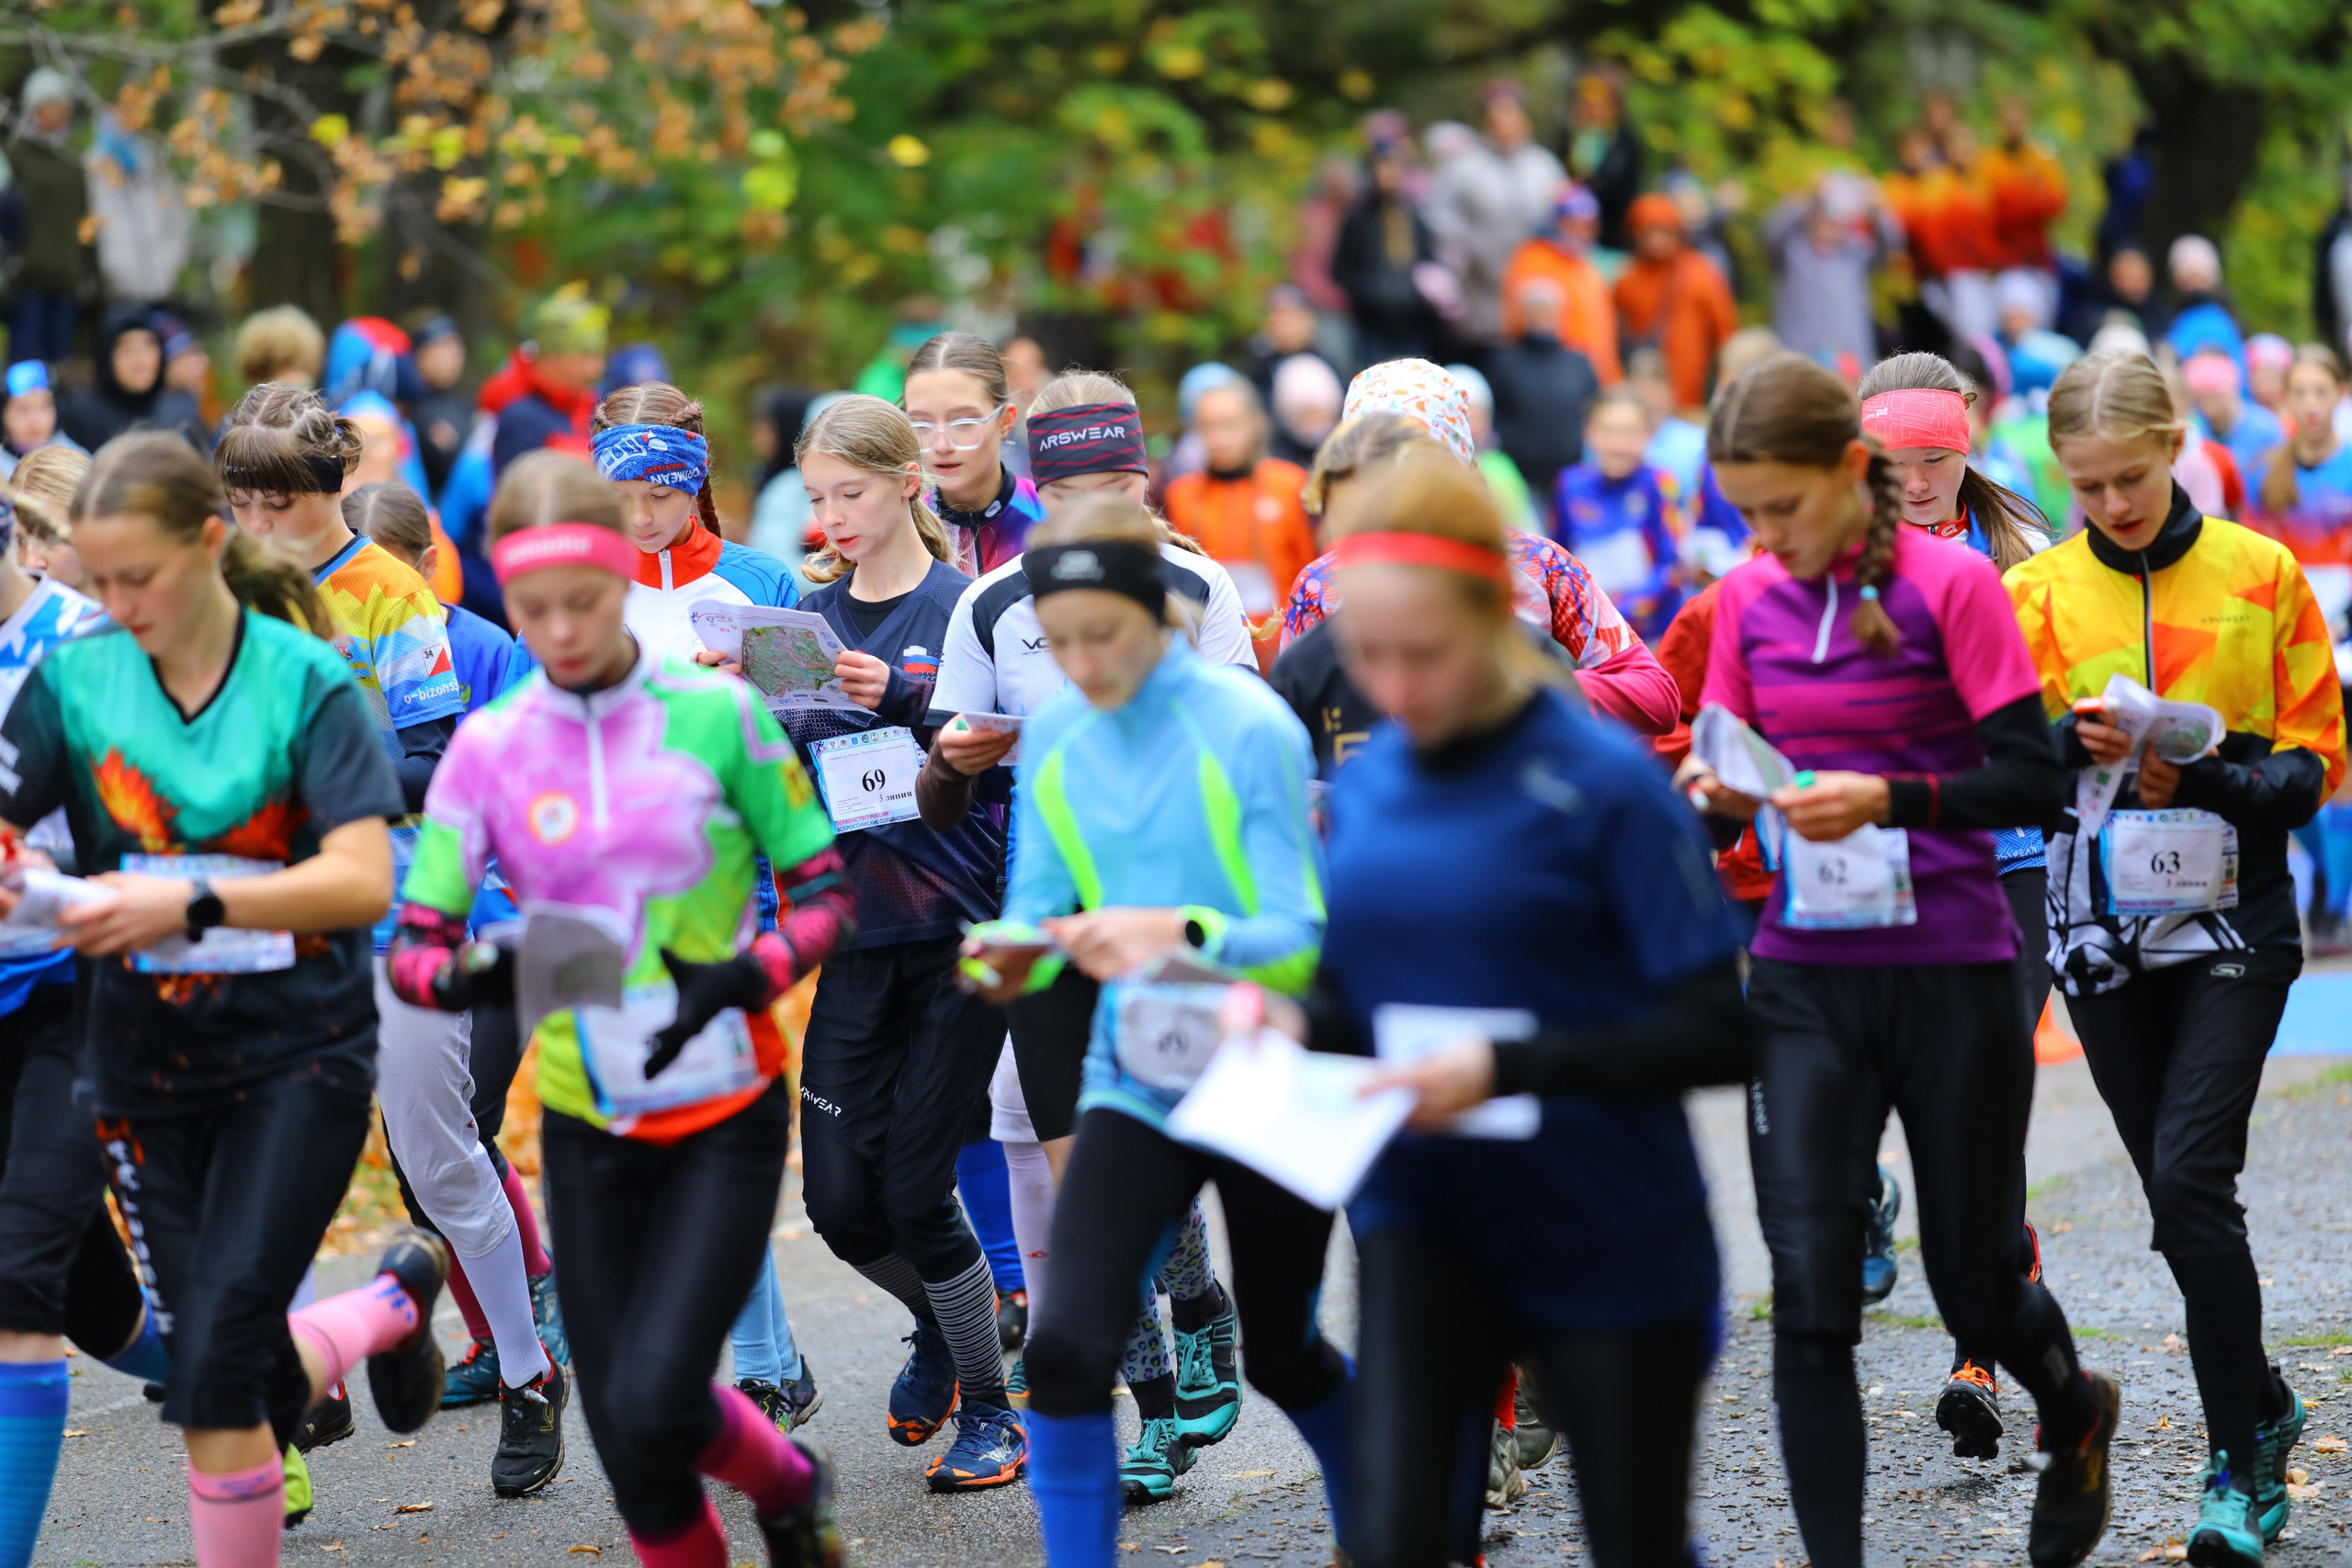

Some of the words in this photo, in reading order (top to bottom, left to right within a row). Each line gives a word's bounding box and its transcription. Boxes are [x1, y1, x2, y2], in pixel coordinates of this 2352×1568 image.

[1039, 426, 1125, 452] ARSWEAR
[650, 466, 700, 486] CRIMEAN
[423, 649, 435, 660] 34
[862, 769, 886, 792] 69
[879, 794, 883, 802] 3
[885, 791, 912, 801] линия
[835, 816, 869, 827] ПЕРВЕНСТВО
[869, 811, 889, 820] РОССИИ
[2151, 851, 2180, 874] 63
